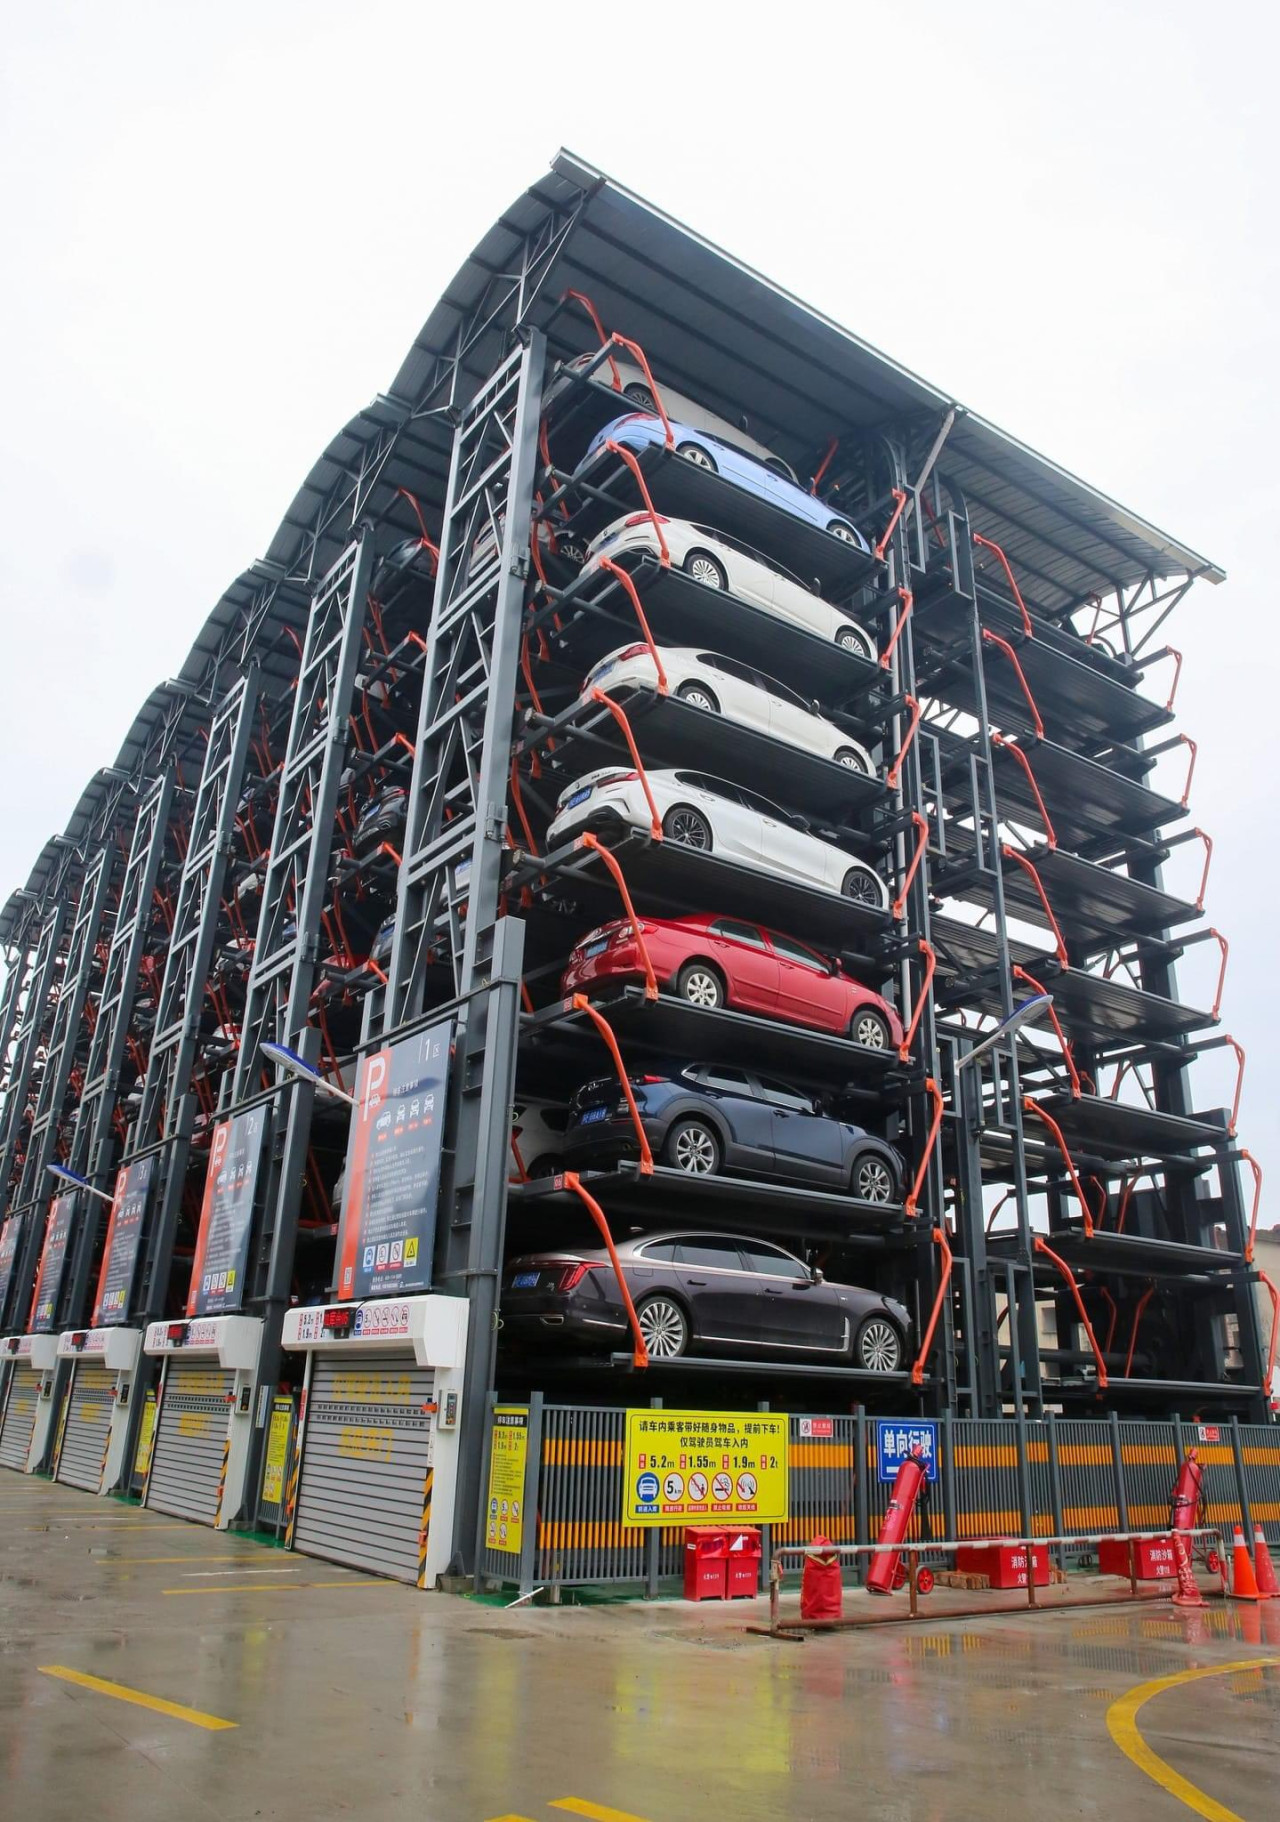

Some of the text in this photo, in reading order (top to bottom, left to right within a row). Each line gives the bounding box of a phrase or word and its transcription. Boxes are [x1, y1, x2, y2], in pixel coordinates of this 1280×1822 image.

[363, 1056, 386, 1122] P
[210, 1127, 227, 1178] P
[680, 1436, 749, 1448] 仅驾驶员驾车入内
[883, 1429, 932, 1459] 单向行驶
[650, 1455, 675, 1468] 5.2m
[688, 1455, 716, 1468] 1.55m
[733, 1455, 755, 1468] 1.9m
[769, 1456, 778, 1468] 2t
